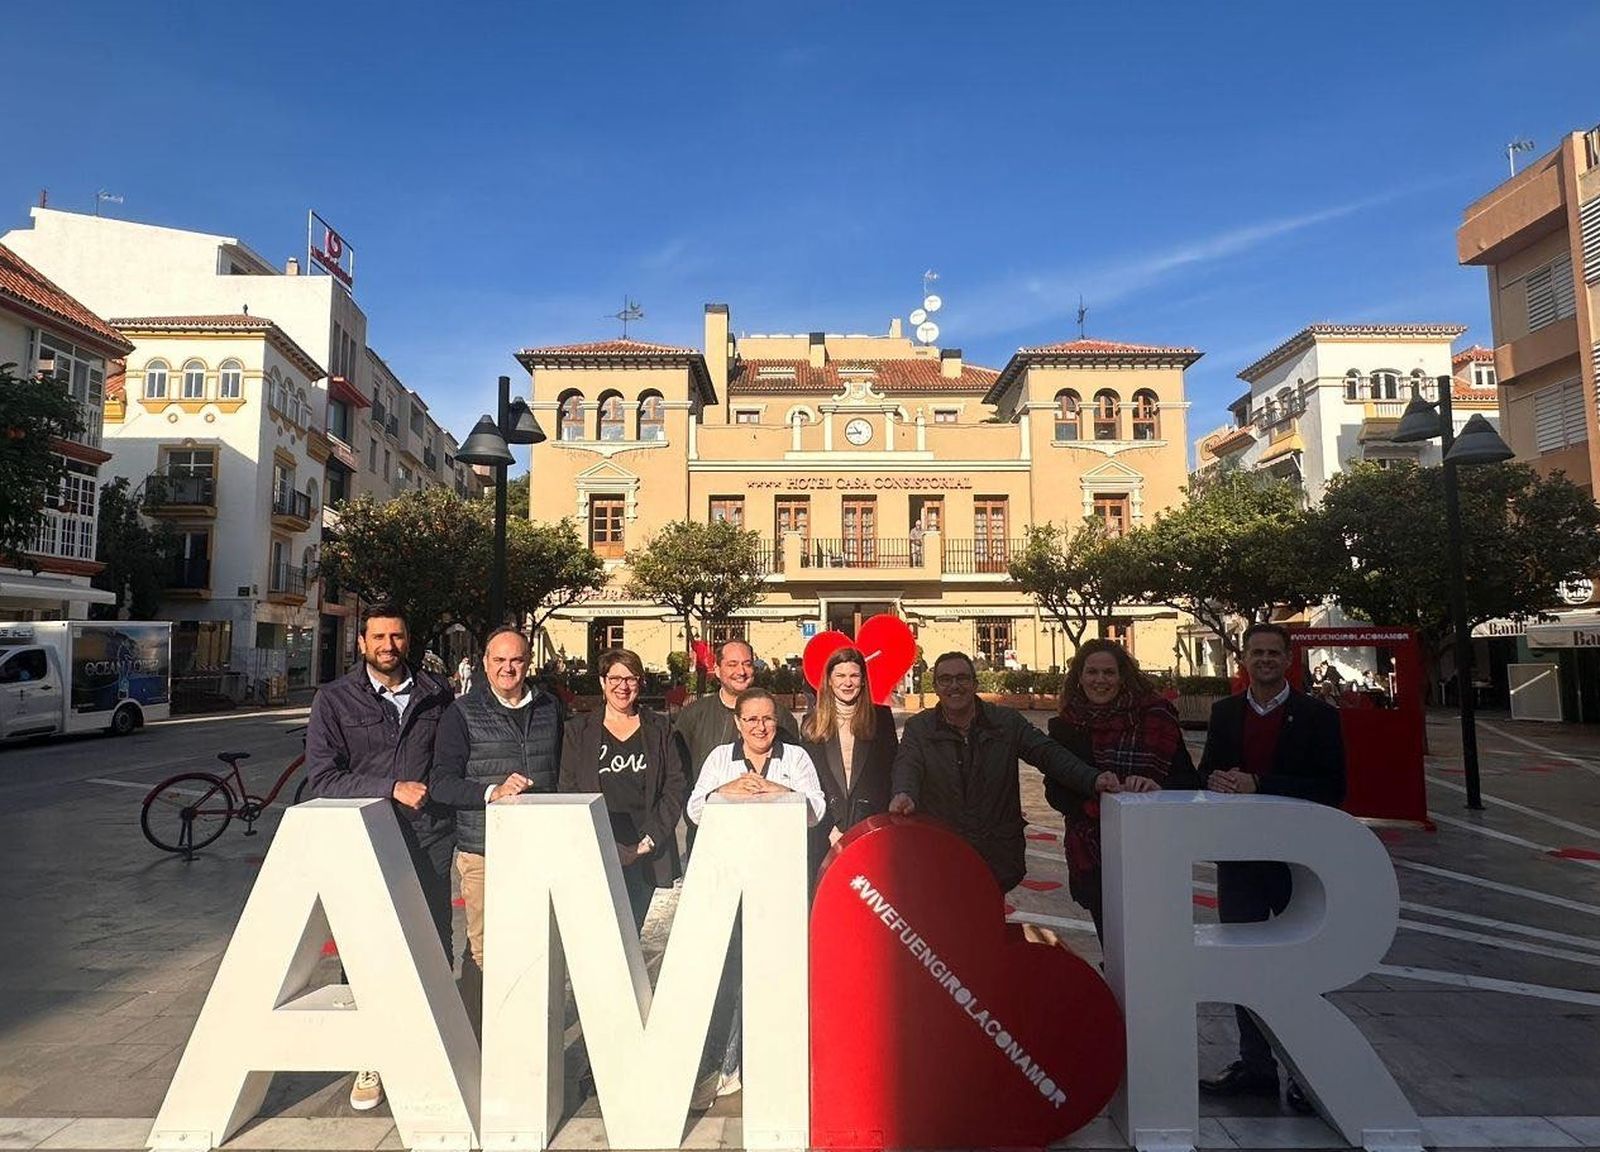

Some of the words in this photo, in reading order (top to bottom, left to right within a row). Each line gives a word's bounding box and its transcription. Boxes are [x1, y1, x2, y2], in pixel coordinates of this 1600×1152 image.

[786, 478, 833, 490] HOTEL
[836, 478, 870, 490] CASA
[873, 478, 973, 490] CONSISTORIAL
[849, 873, 1068, 1111] #VIVEFUENGIROLACONAMOR
